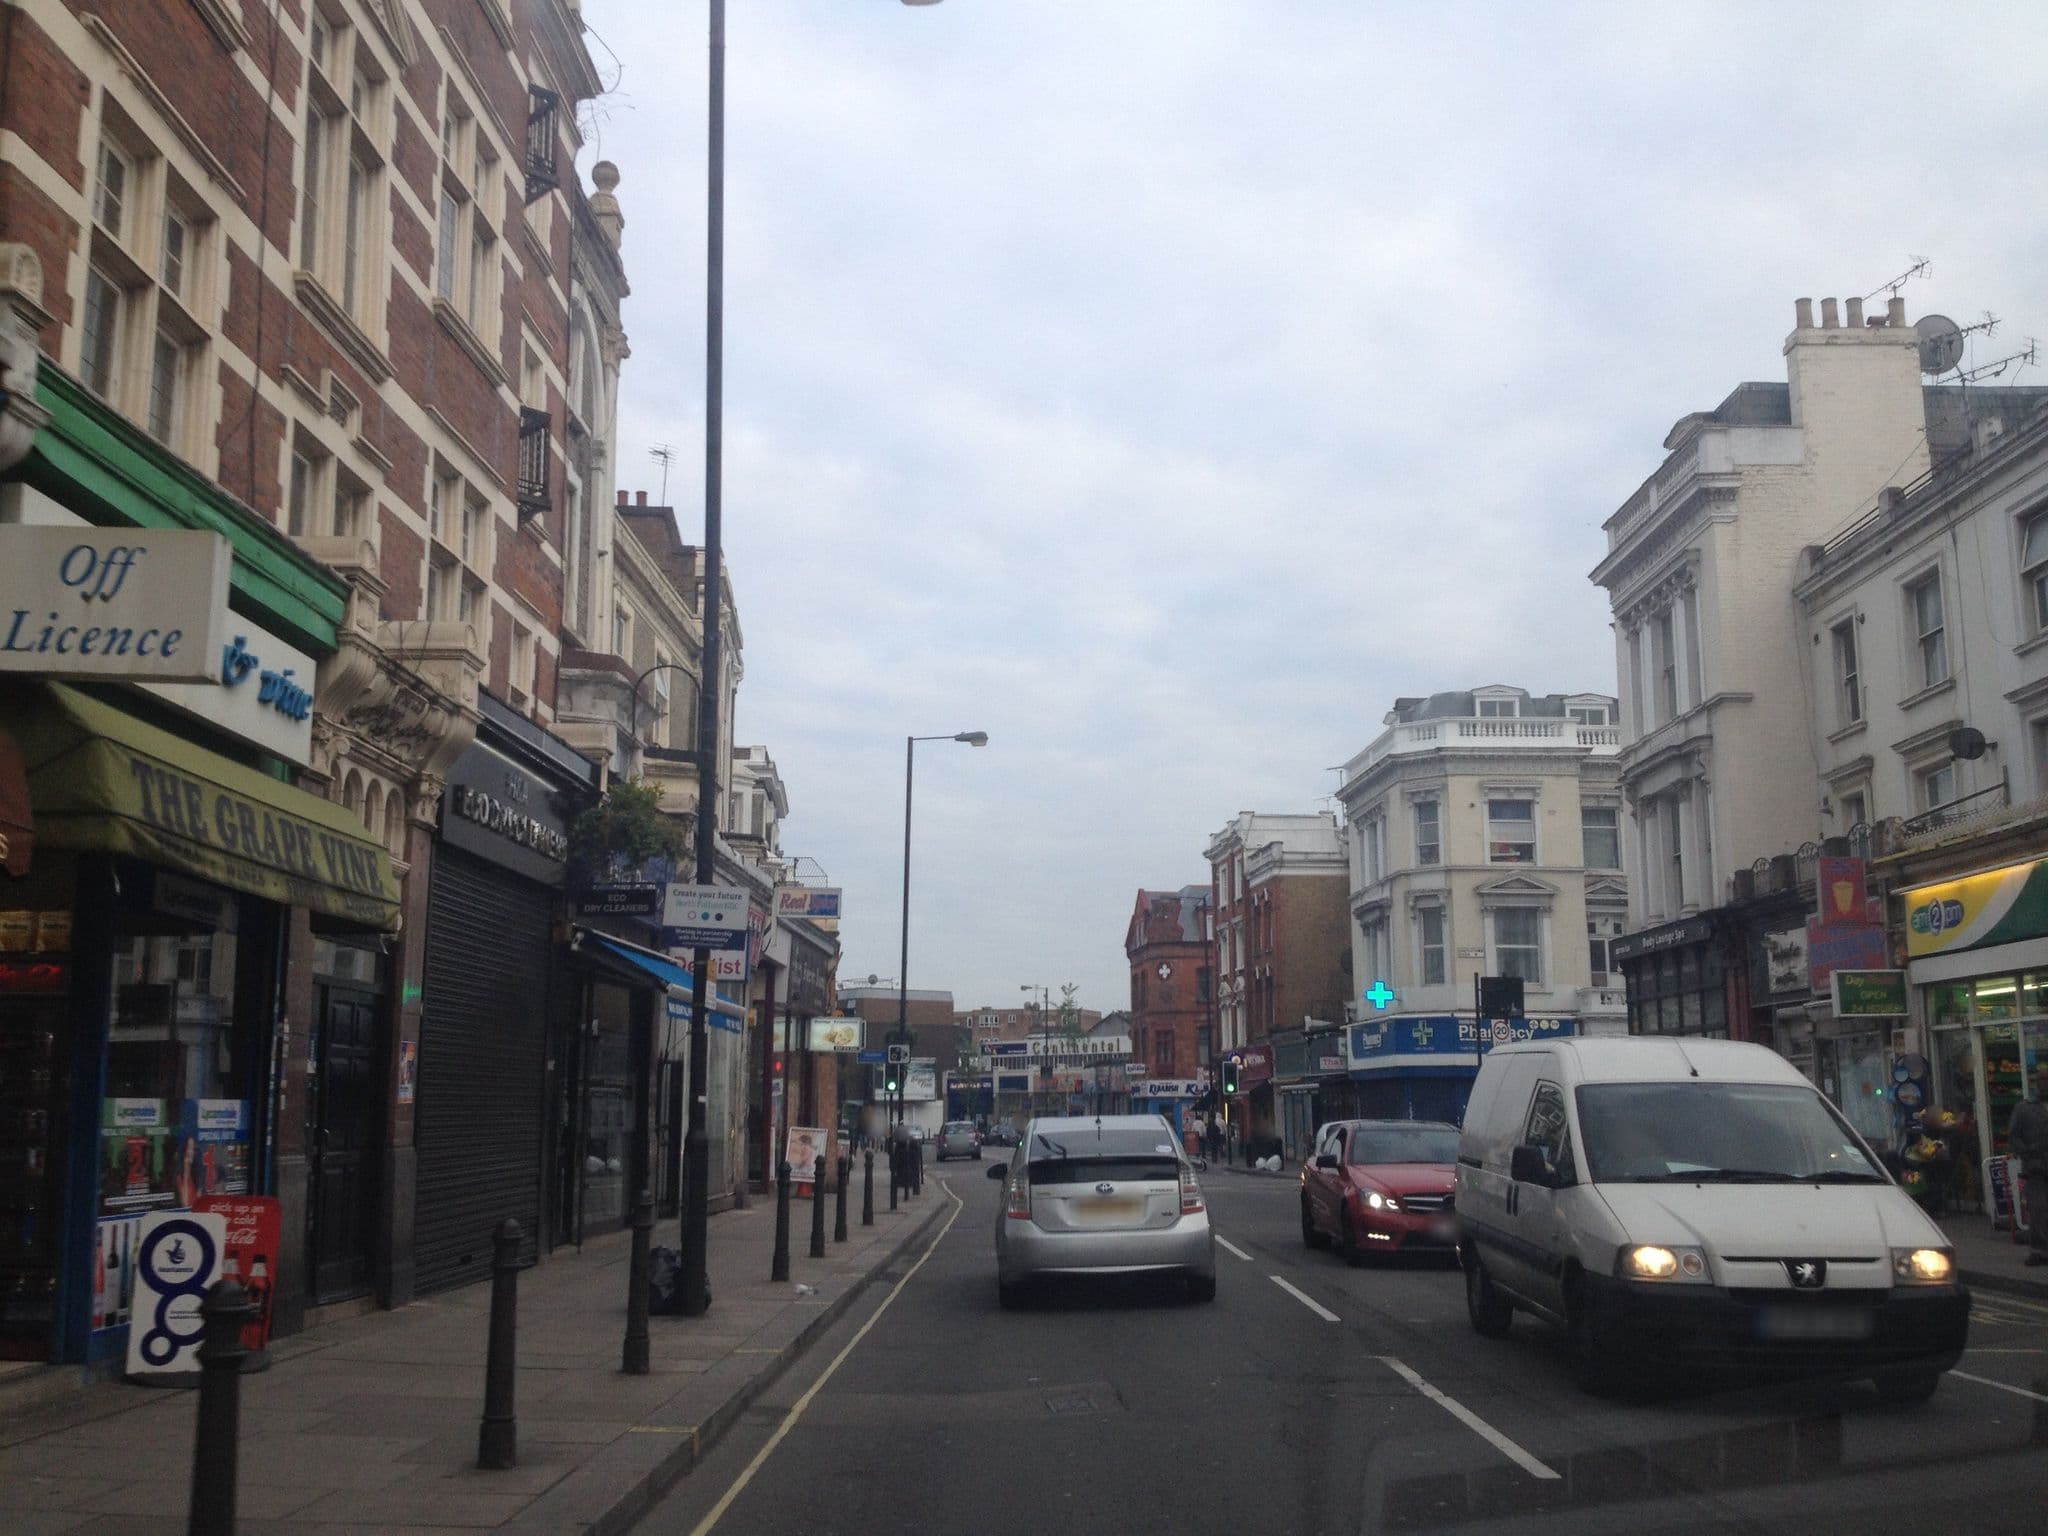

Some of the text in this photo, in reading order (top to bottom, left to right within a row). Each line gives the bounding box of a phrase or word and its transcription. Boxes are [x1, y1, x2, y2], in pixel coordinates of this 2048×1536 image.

[60, 544, 147, 602] Off
[0, 609, 183, 657] Licence
[131, 758, 384, 896] THE GRAPE VINE
[673, 889, 742, 901] Create your future
[584, 904, 649, 913] DRY CLEANERS
[674, 956, 741, 975] Deist
[1458, 1024, 1535, 1042] Pharacy
[1496, 1025, 1507, 1036] 20
[210, 1203, 231, 1213] pick
[236, 1205, 249, 1214] up
[233, 1216, 257, 1225] cold
